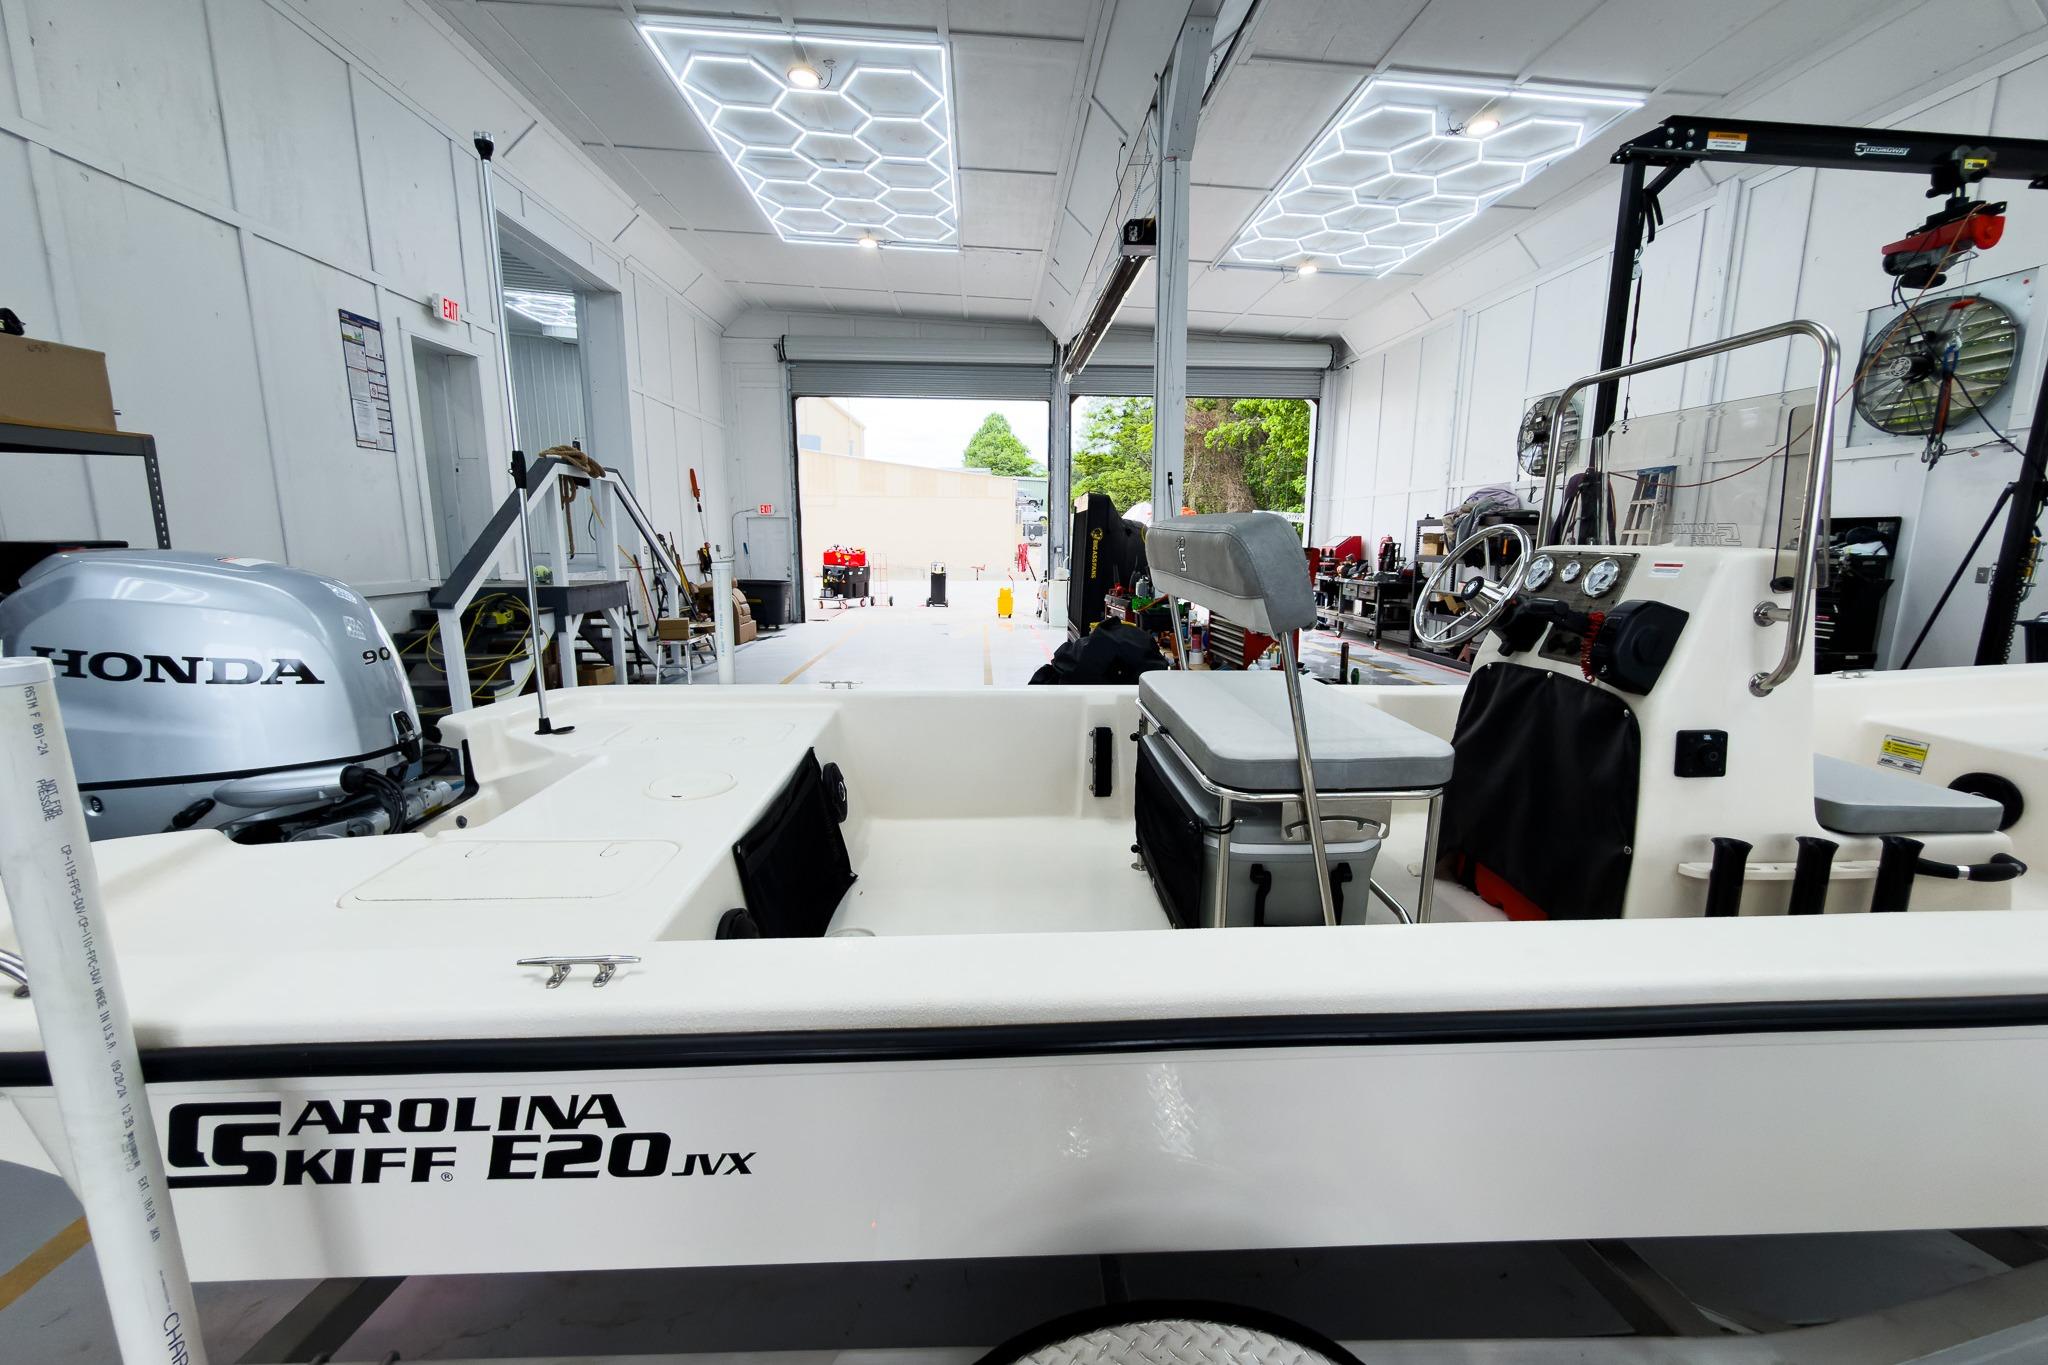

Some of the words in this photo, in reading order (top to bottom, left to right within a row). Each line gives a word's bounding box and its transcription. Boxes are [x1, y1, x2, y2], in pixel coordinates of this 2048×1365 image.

[443, 298, 458, 321] EXIT
[760, 504, 772, 513] EXIT
[31, 646, 325, 685] HONDA
[362, 646, 391, 665] 90
[24, 685, 38, 709] ASTM
[32, 723, 49, 756] 891-24
[36, 779, 56, 822] PRESSURE
[50, 799, 64, 817] FOR
[100, 1010, 112, 1023] IN
[487, 1132, 672, 1180] E20
[672, 1151, 757, 1177] JVX
